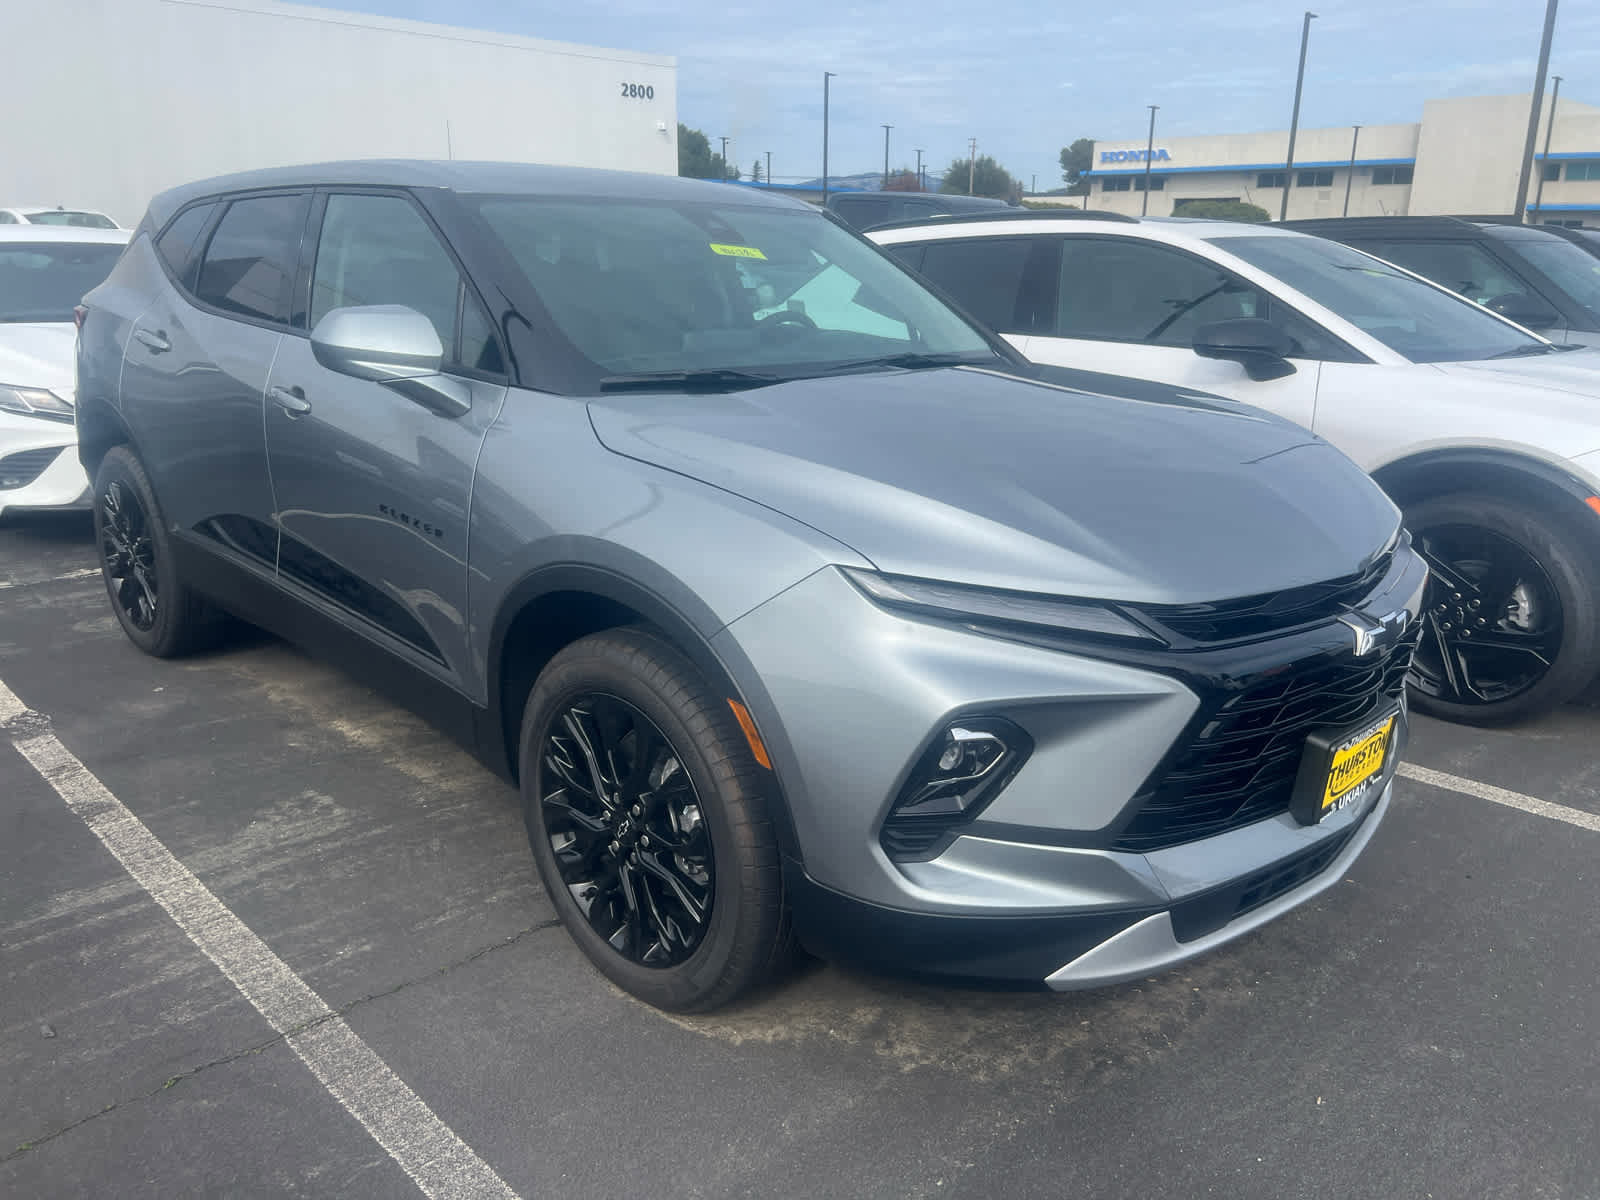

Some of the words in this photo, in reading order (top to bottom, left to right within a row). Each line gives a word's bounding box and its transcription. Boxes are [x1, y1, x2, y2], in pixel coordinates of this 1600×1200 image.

[621, 83, 654, 100] 2800
[1100, 149, 1171, 163] HONDA
[1328, 730, 1389, 789] THURSTON
[1338, 781, 1367, 809] UKIAH
